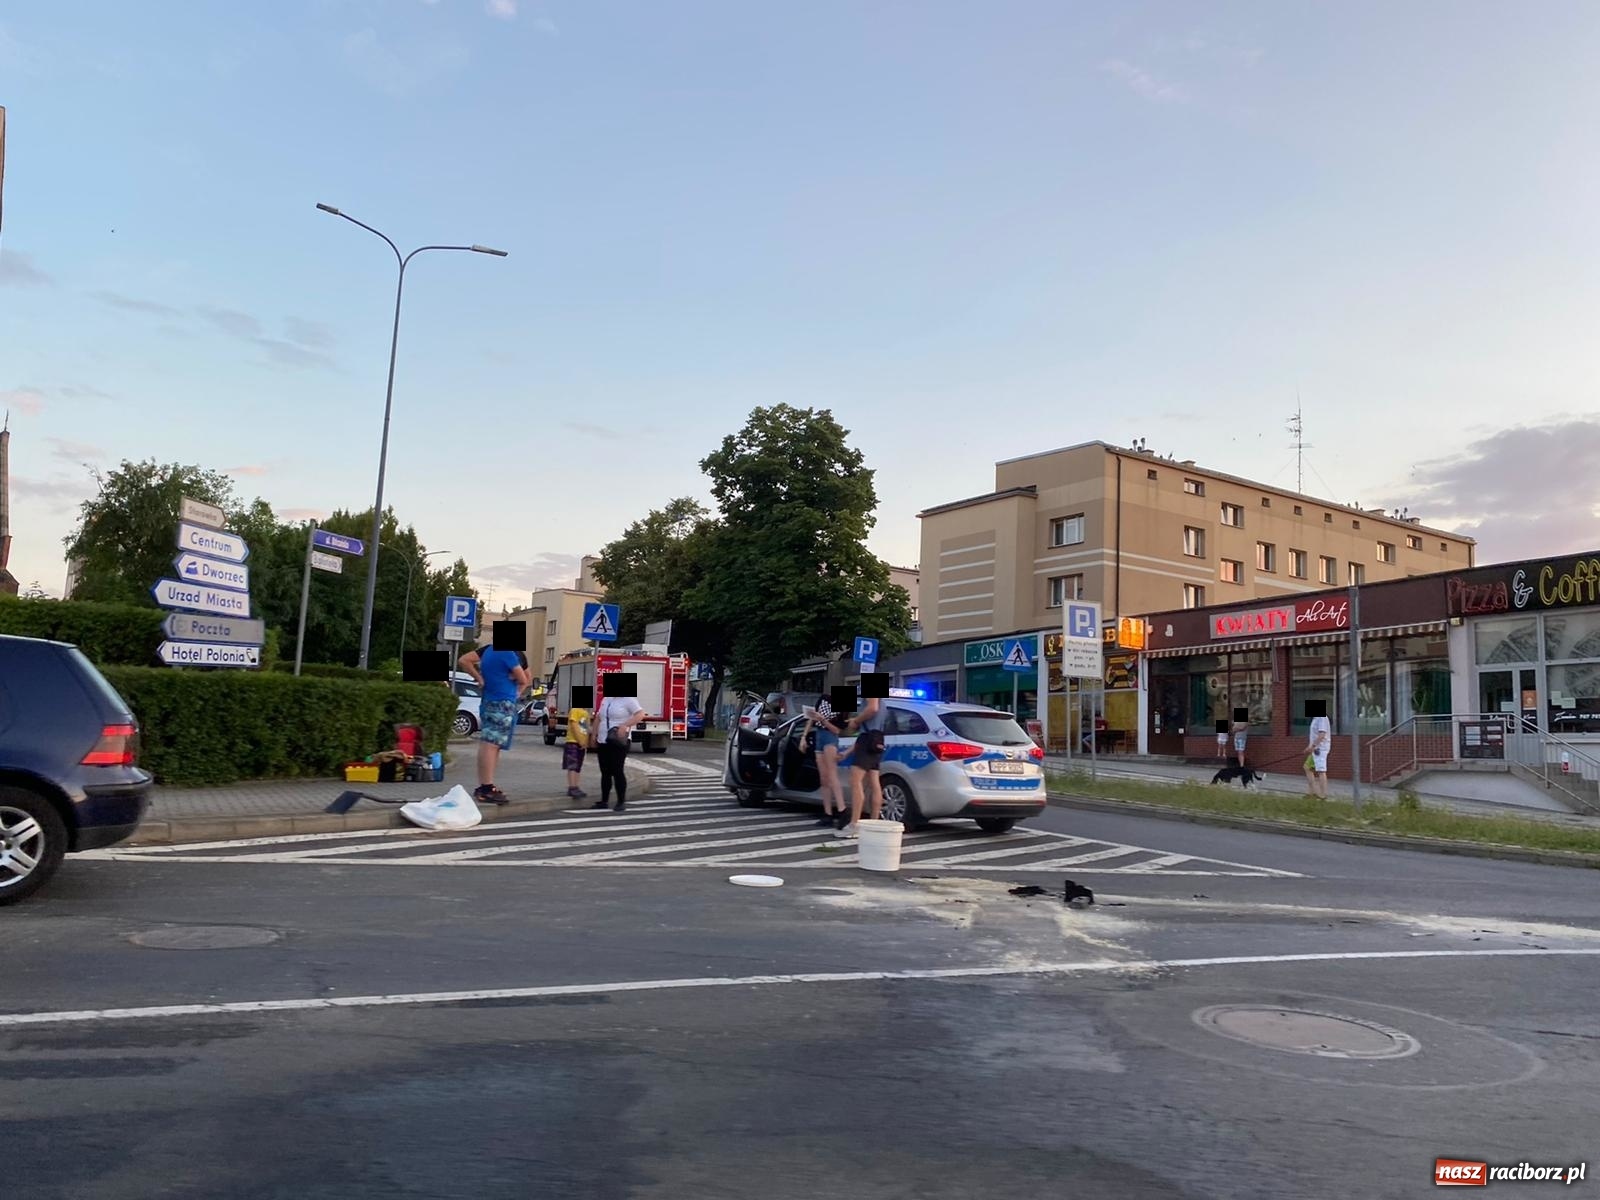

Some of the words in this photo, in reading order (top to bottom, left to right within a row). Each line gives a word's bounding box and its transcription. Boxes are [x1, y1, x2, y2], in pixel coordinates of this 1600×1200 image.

[190, 532, 233, 553] Centrum
[202, 563, 244, 584] Dworzec
[1446, 576, 1508, 615] Pizza
[1512, 569, 1534, 608] &
[1539, 559, 1600, 606] Coff
[206, 593, 243, 610] Miasta
[191, 620, 231, 637] Poczta
[1215, 608, 1291, 635] KWIATY
[171, 646, 203, 662] Hotel
[206, 648, 245, 663] Polonia
